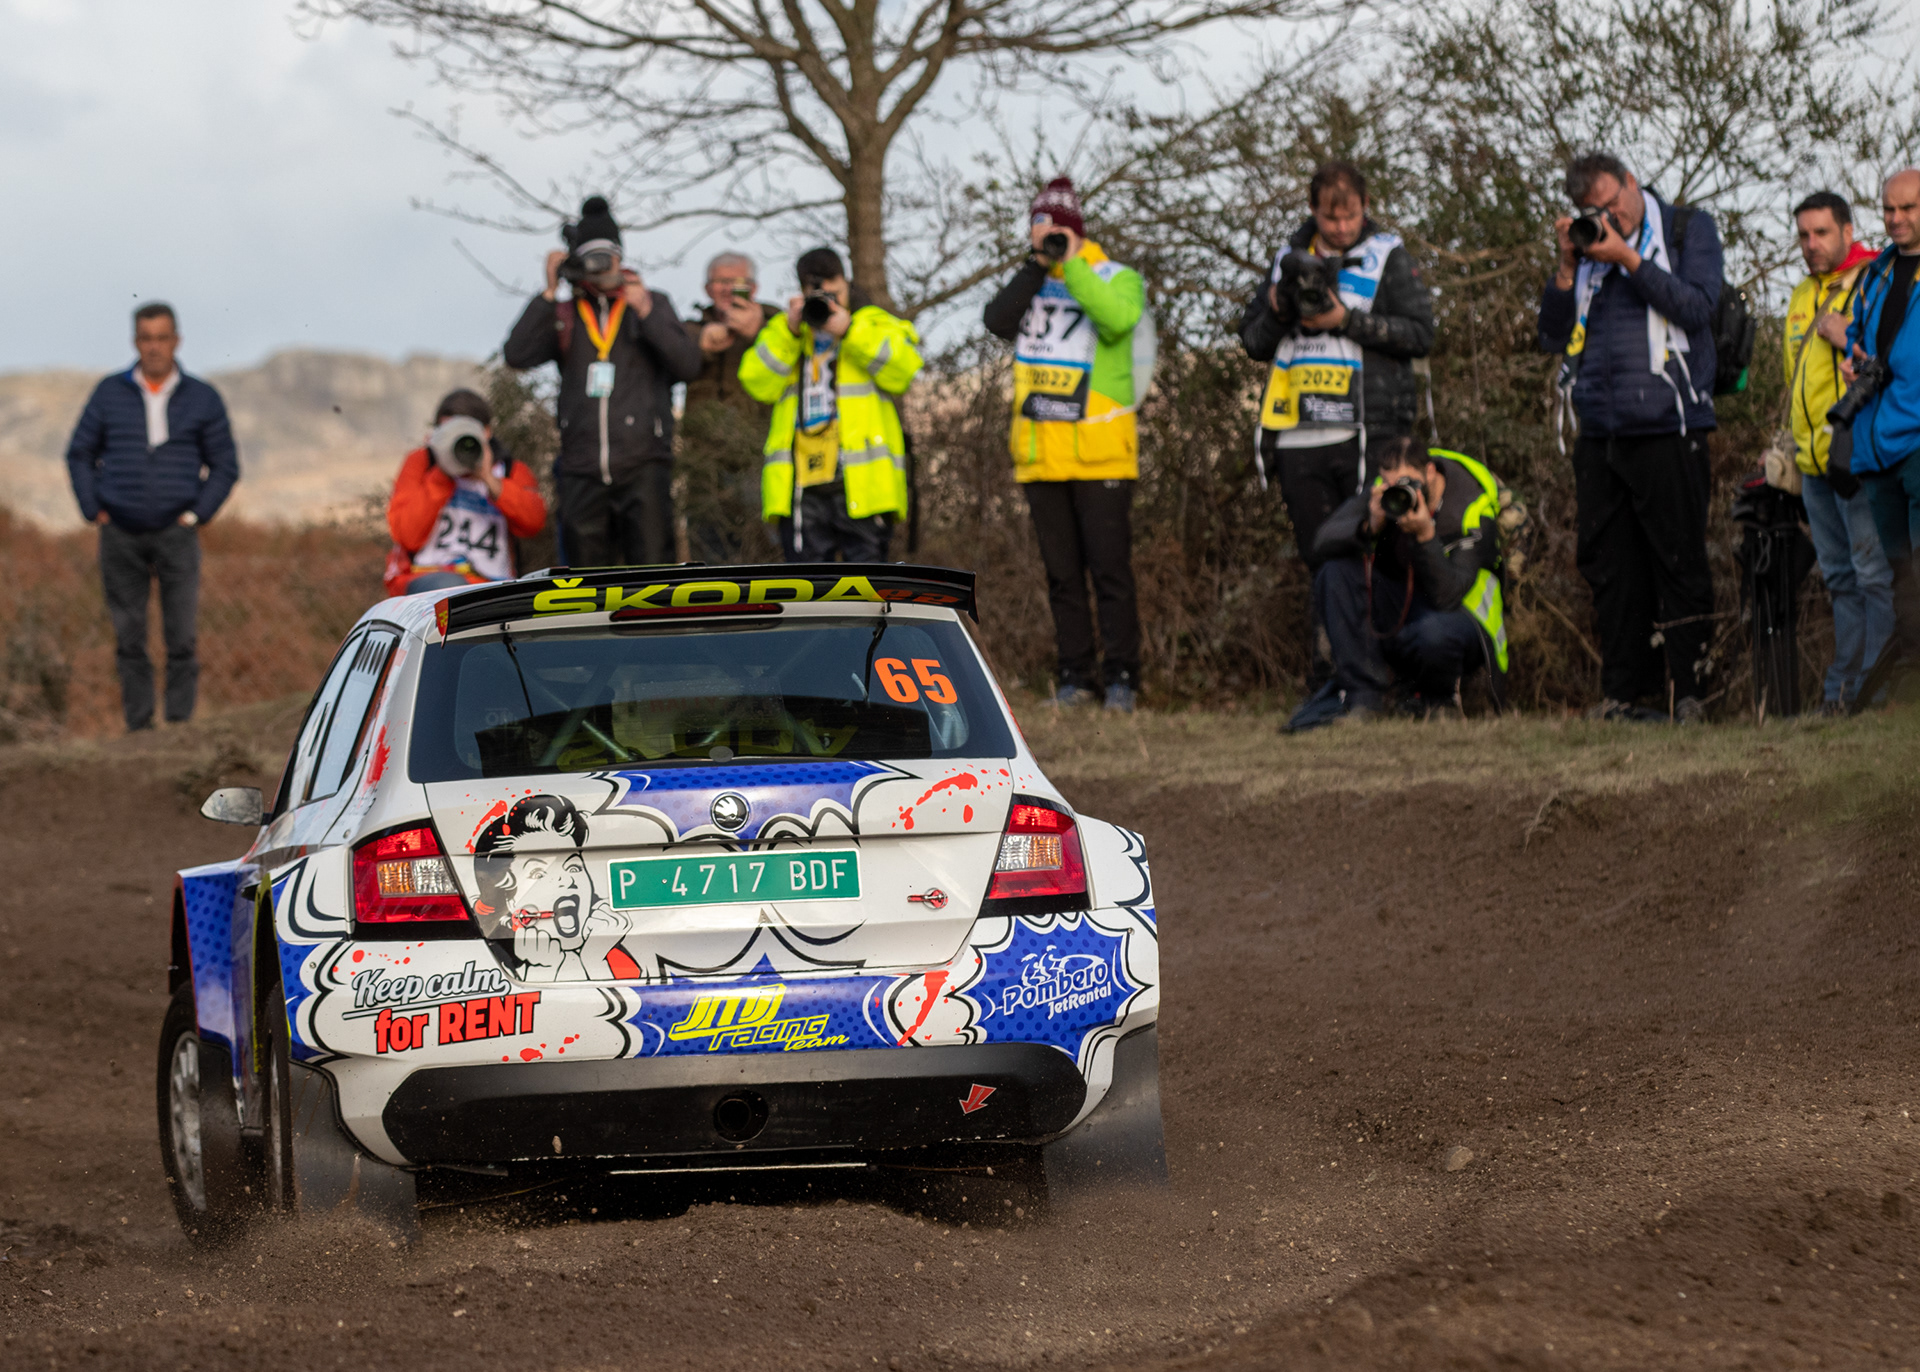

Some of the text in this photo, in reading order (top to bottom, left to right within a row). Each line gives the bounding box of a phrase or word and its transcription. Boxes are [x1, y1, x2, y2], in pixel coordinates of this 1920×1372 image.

[1303, 368, 1346, 388] 2022
[532, 576, 887, 618] ŠKODA
[874, 657, 958, 705] 65
[619, 859, 848, 900] P 4717 BDF
[352, 960, 512, 1009] Keep calm
[1002, 961, 1109, 1016] Pombero
[1047, 980, 1112, 1020] JetRental
[374, 991, 541, 1054] for RENT
[784, 1034, 850, 1051] team
